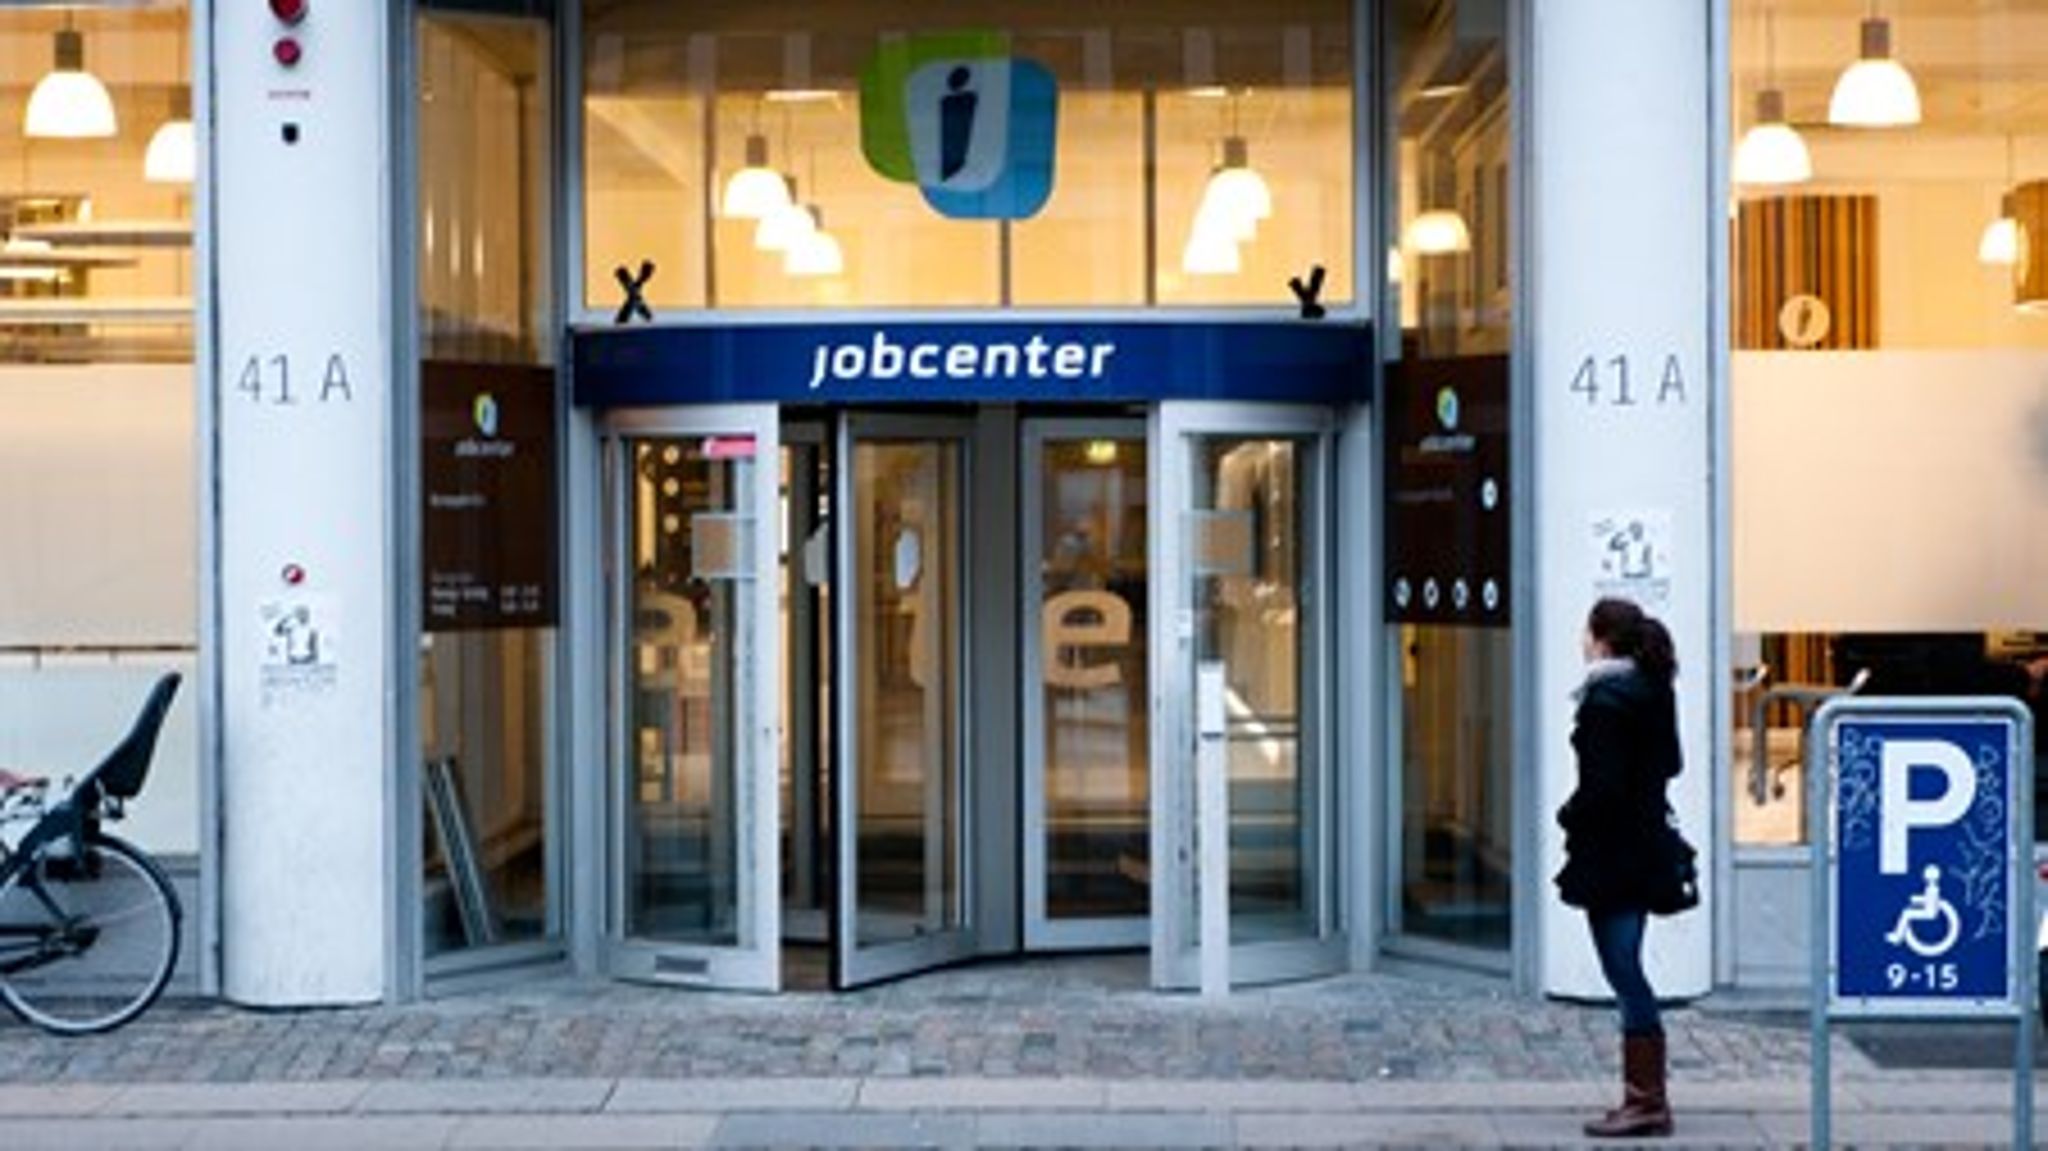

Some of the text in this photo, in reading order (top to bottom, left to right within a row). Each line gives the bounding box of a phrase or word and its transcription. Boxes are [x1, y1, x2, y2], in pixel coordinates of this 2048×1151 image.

[237, 354, 352, 405] 41 A
[809, 331, 1115, 389] jobcenter
[1570, 354, 1687, 405] 41 A
[1879, 739, 1976, 875] P
